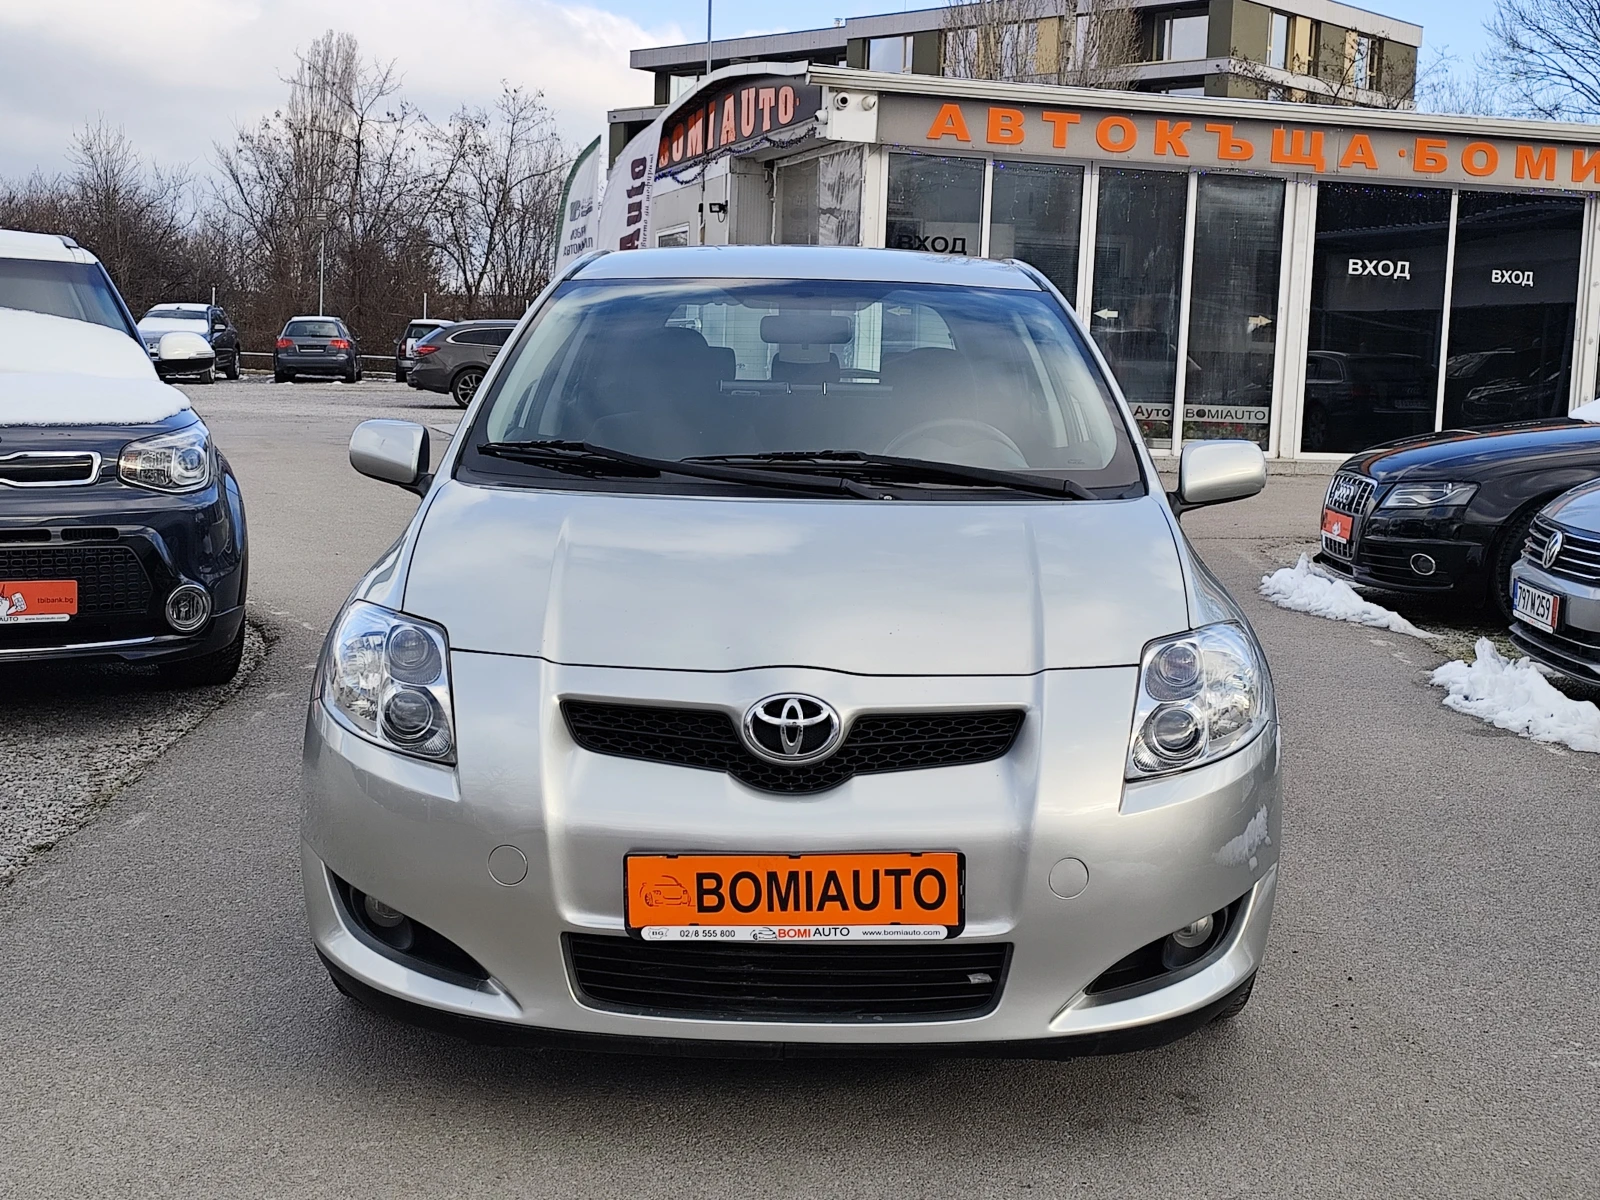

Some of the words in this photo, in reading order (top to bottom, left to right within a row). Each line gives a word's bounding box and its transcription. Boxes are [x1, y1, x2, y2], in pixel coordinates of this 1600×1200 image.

[658, 85, 795, 168] BOMIAUTO
[926, 103, 1379, 173] АВТОКЪЩА
[1413, 138, 1600, 183] БОМИ
[901, 235, 967, 255] ВХОД
[1348, 259, 1410, 280] ВХОД
[1491, 269, 1534, 287] ВХОД
[695, 868, 947, 914] BOMIAUTO
[679, 929, 699, 938] 02/8
[702, 929, 717, 938] 555
[720, 929, 736, 938] 800
[777, 928, 811, 938] BOMI
[813, 927, 850, 937] AUTO
[861, 928, 941, 937] www.bomiauto.com
